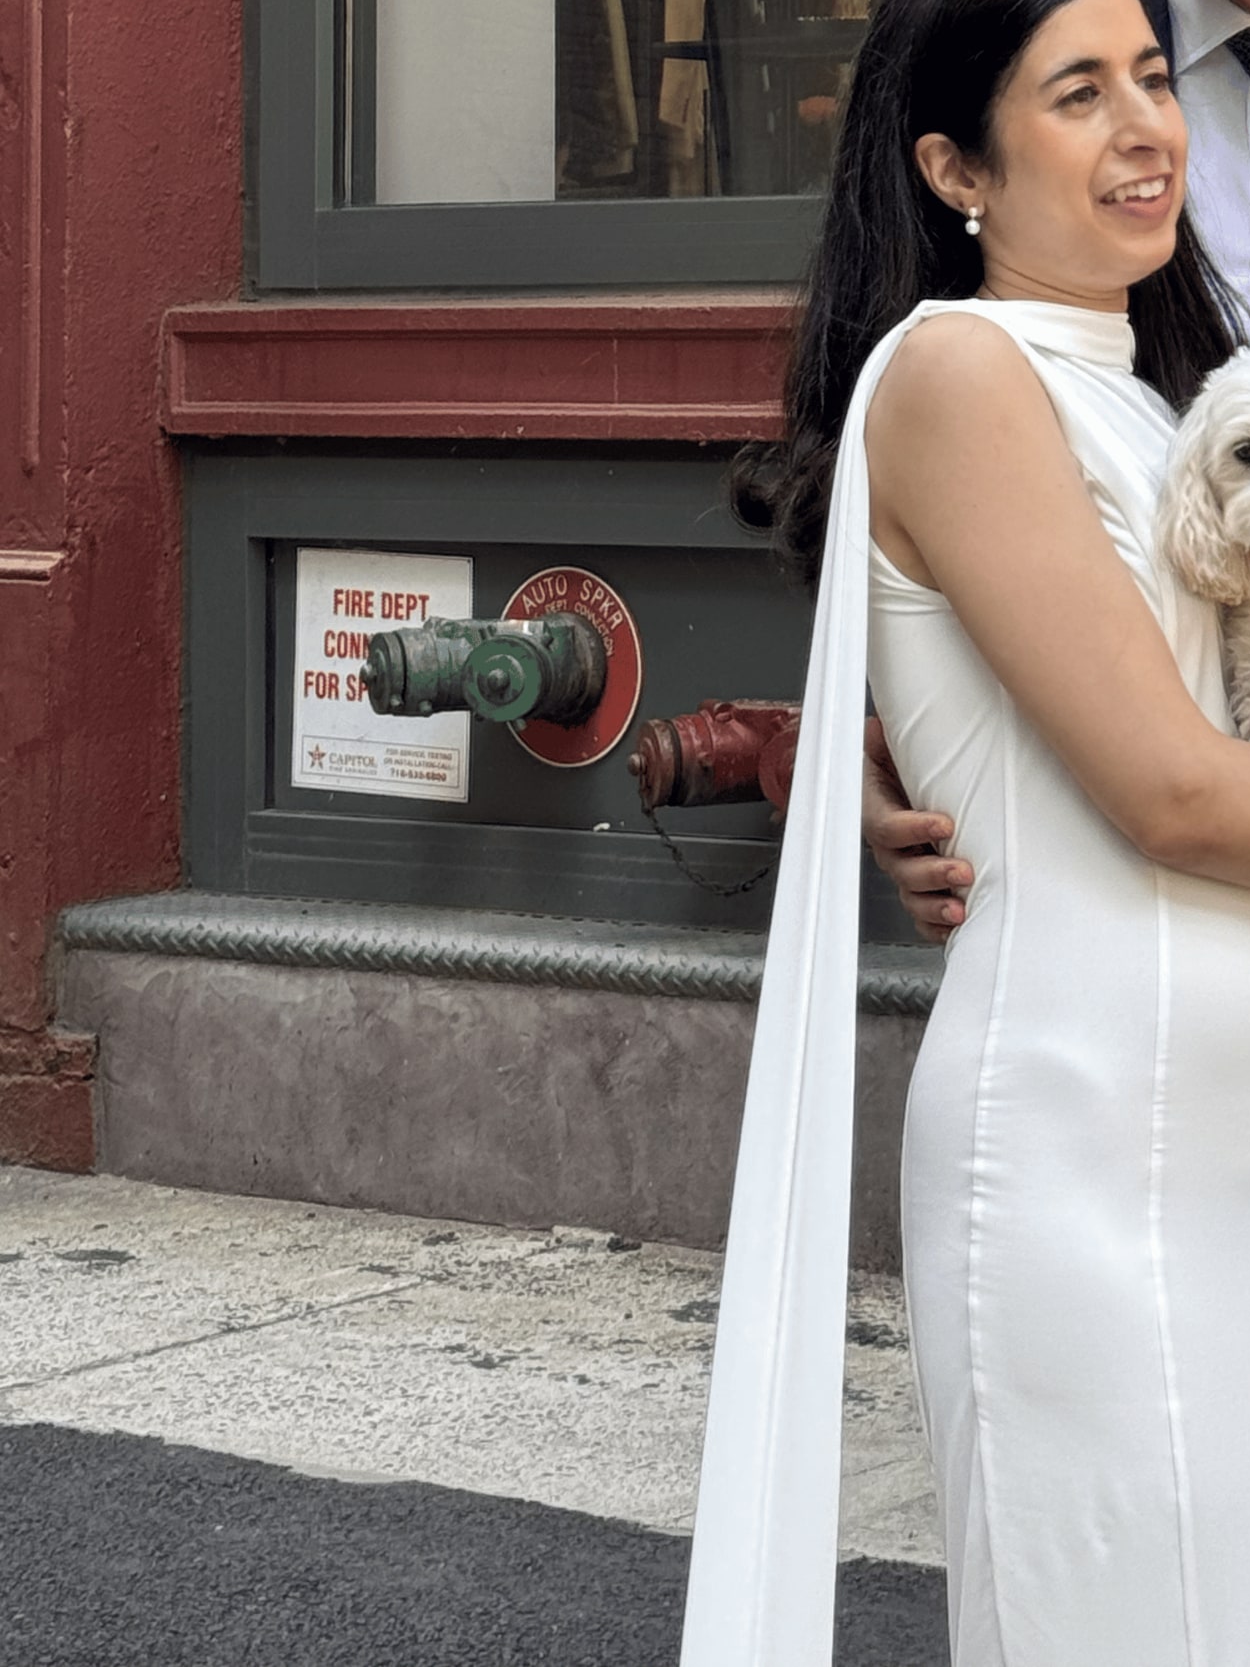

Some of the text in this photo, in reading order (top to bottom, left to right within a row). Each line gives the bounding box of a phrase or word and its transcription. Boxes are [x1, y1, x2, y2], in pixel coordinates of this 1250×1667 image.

[333, 588, 429, 622] FIRE DEPT
[522, 574, 623, 630] AUTO SPKR
[304, 670, 340, 701] FOR
[329, 752, 378, 769] CAPITOL
